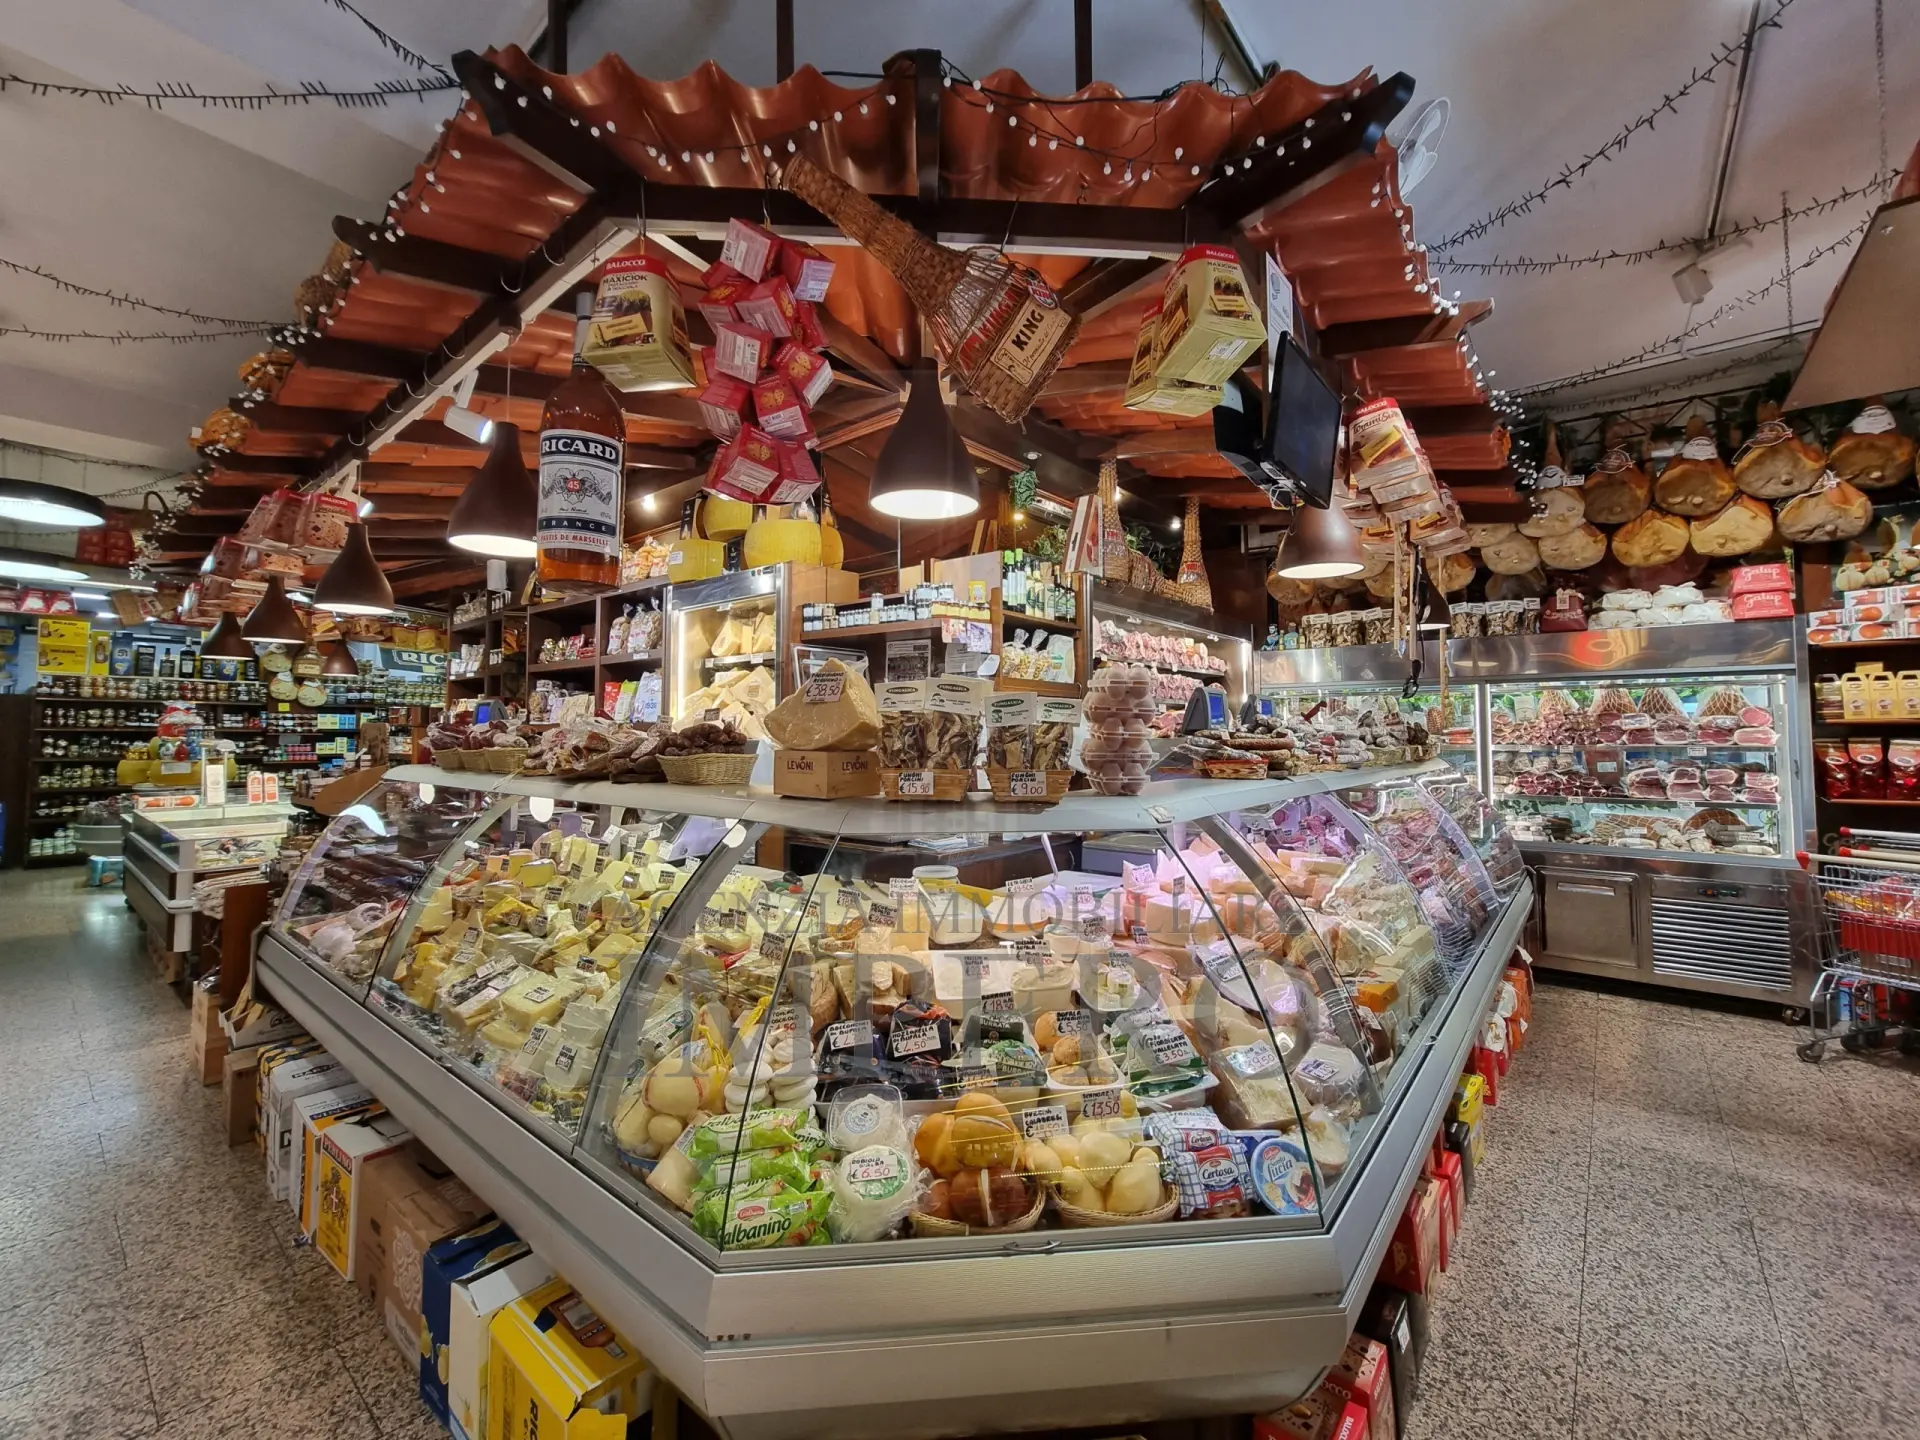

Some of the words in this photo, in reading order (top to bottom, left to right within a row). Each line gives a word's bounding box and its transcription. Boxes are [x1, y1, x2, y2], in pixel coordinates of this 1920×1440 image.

[606, 259, 646, 270] BALOCCO
[1011, 308, 1045, 352] KING
[541, 438, 616, 461] RICARD
[566, 481, 579, 490] 45
[543, 520, 607, 532] FRANCE
[401, 651, 446, 666] RIC
[787, 760, 814, 771] LEVONI
[842, 760, 868, 772] LEVONI
[1202, 1165, 1235, 1178] Certosa
[1321, 1380, 1352, 1399] OCCO
[529, 1397, 538, 1440] RIC
